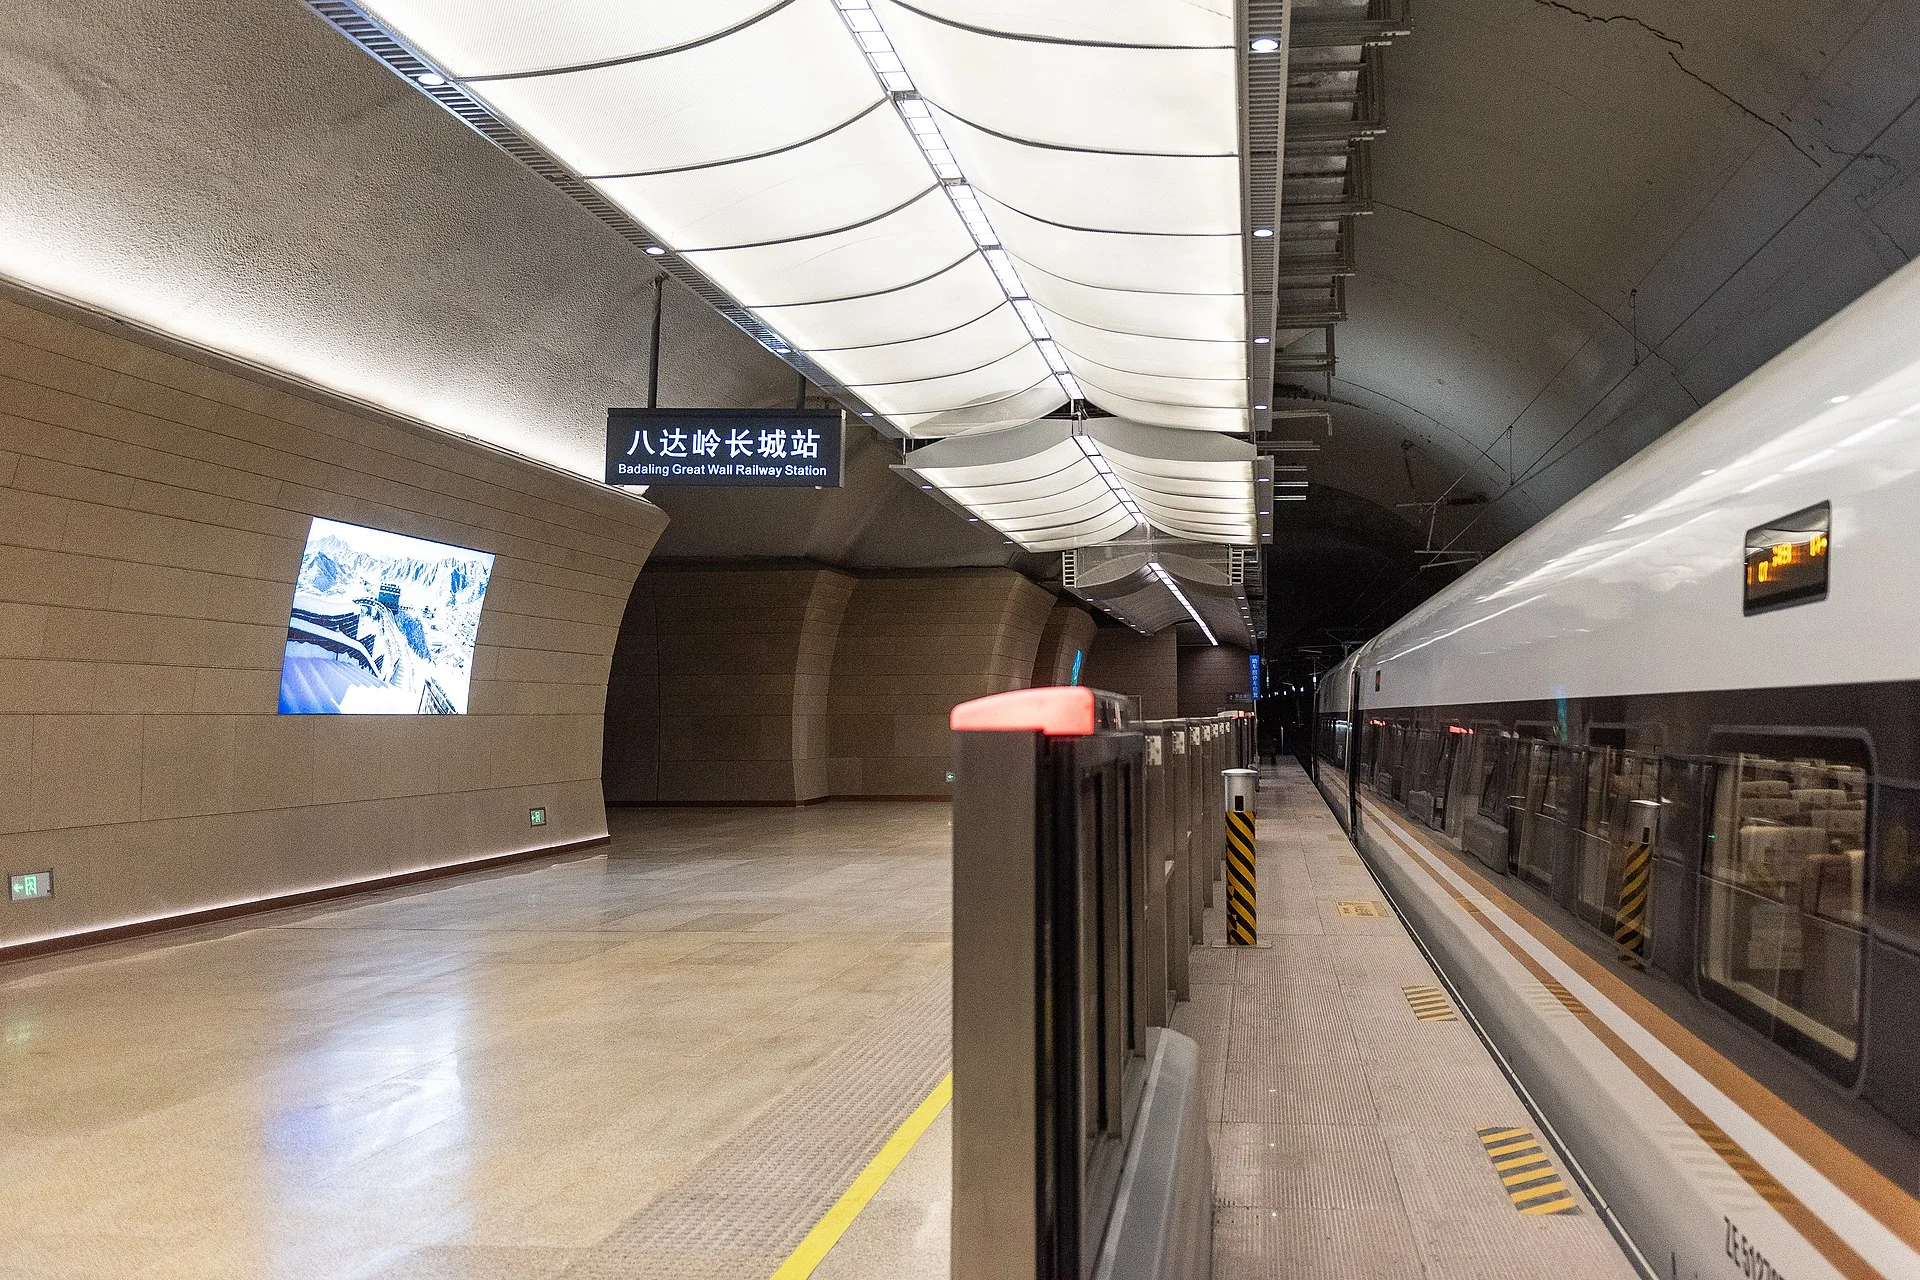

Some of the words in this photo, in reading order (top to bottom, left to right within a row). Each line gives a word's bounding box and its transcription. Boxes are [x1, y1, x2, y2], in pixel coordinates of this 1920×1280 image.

[626, 428, 821, 459] 八达岭长城站
[618, 463, 669, 476] Badaling
[671, 464, 705, 475] Great
[707, 464, 733, 475] Wall
[735, 465, 783, 478] Railway
[784, 465, 827, 476] Station
